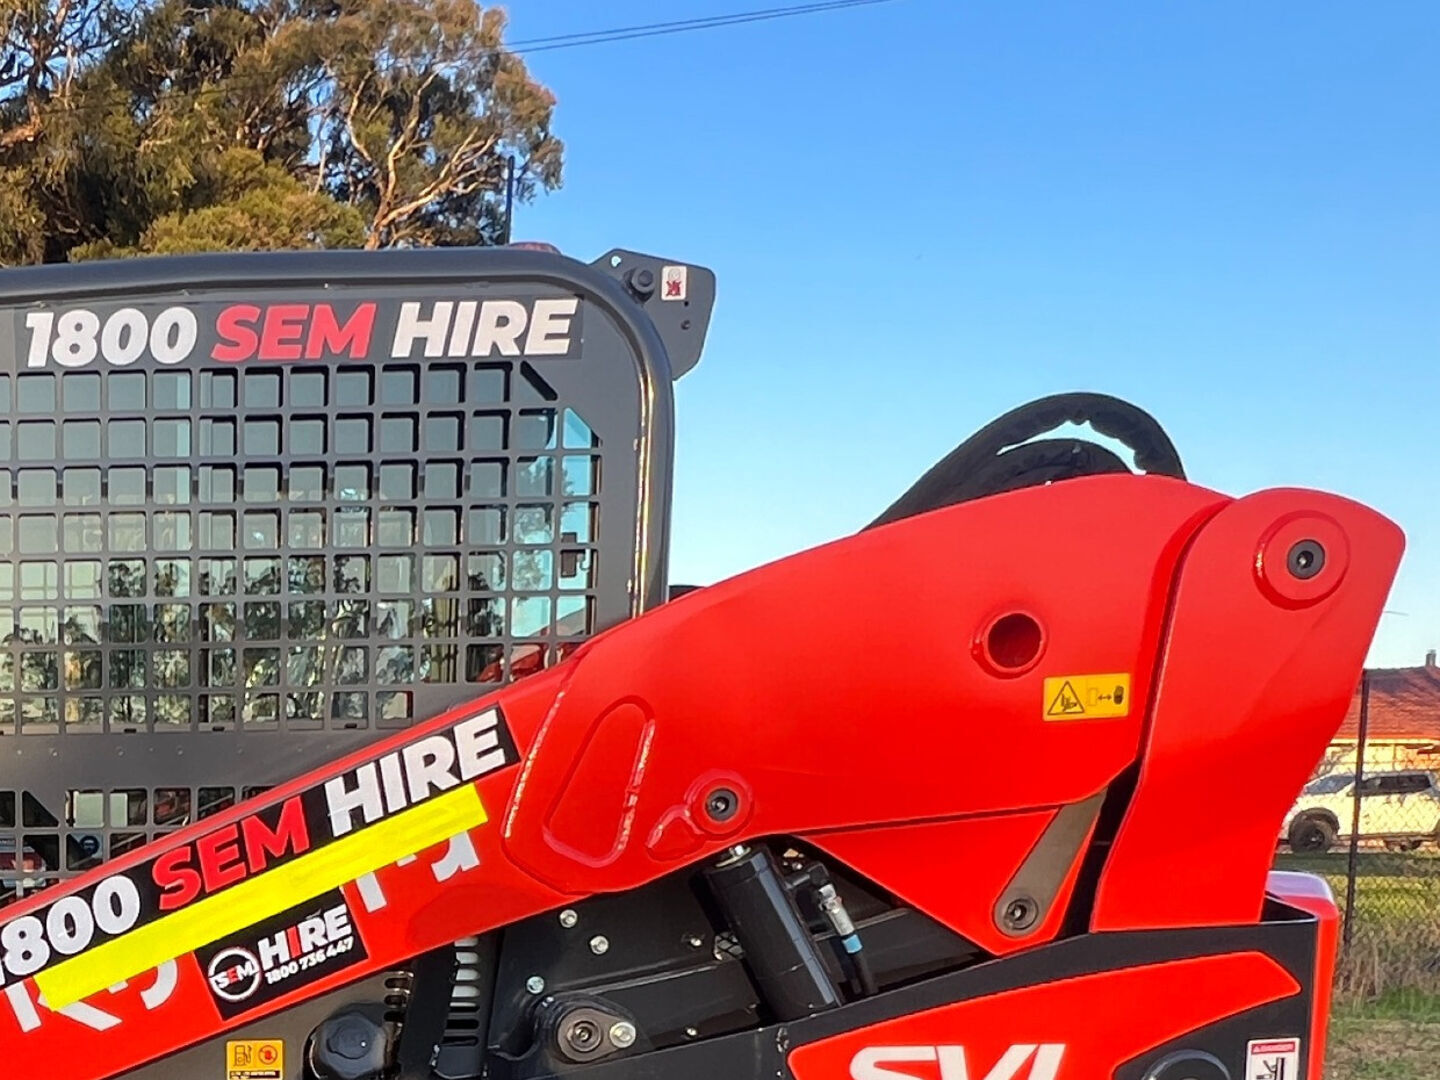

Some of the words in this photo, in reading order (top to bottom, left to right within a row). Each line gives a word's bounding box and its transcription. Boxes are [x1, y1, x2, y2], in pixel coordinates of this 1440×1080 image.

[25, 307, 198, 368] 1800
[210, 302, 377, 362] SEM
[390, 298, 578, 358] HIRE
[152, 796, 309, 911] SEM
[326, 709, 507, 838] HIRE
[258, 904, 352, 971] HIRE
[265, 963, 299, 985] 1800
[299, 949, 327, 971] 736
[326, 936, 354, 958] 447
[213, 960, 257, 989] SEM
